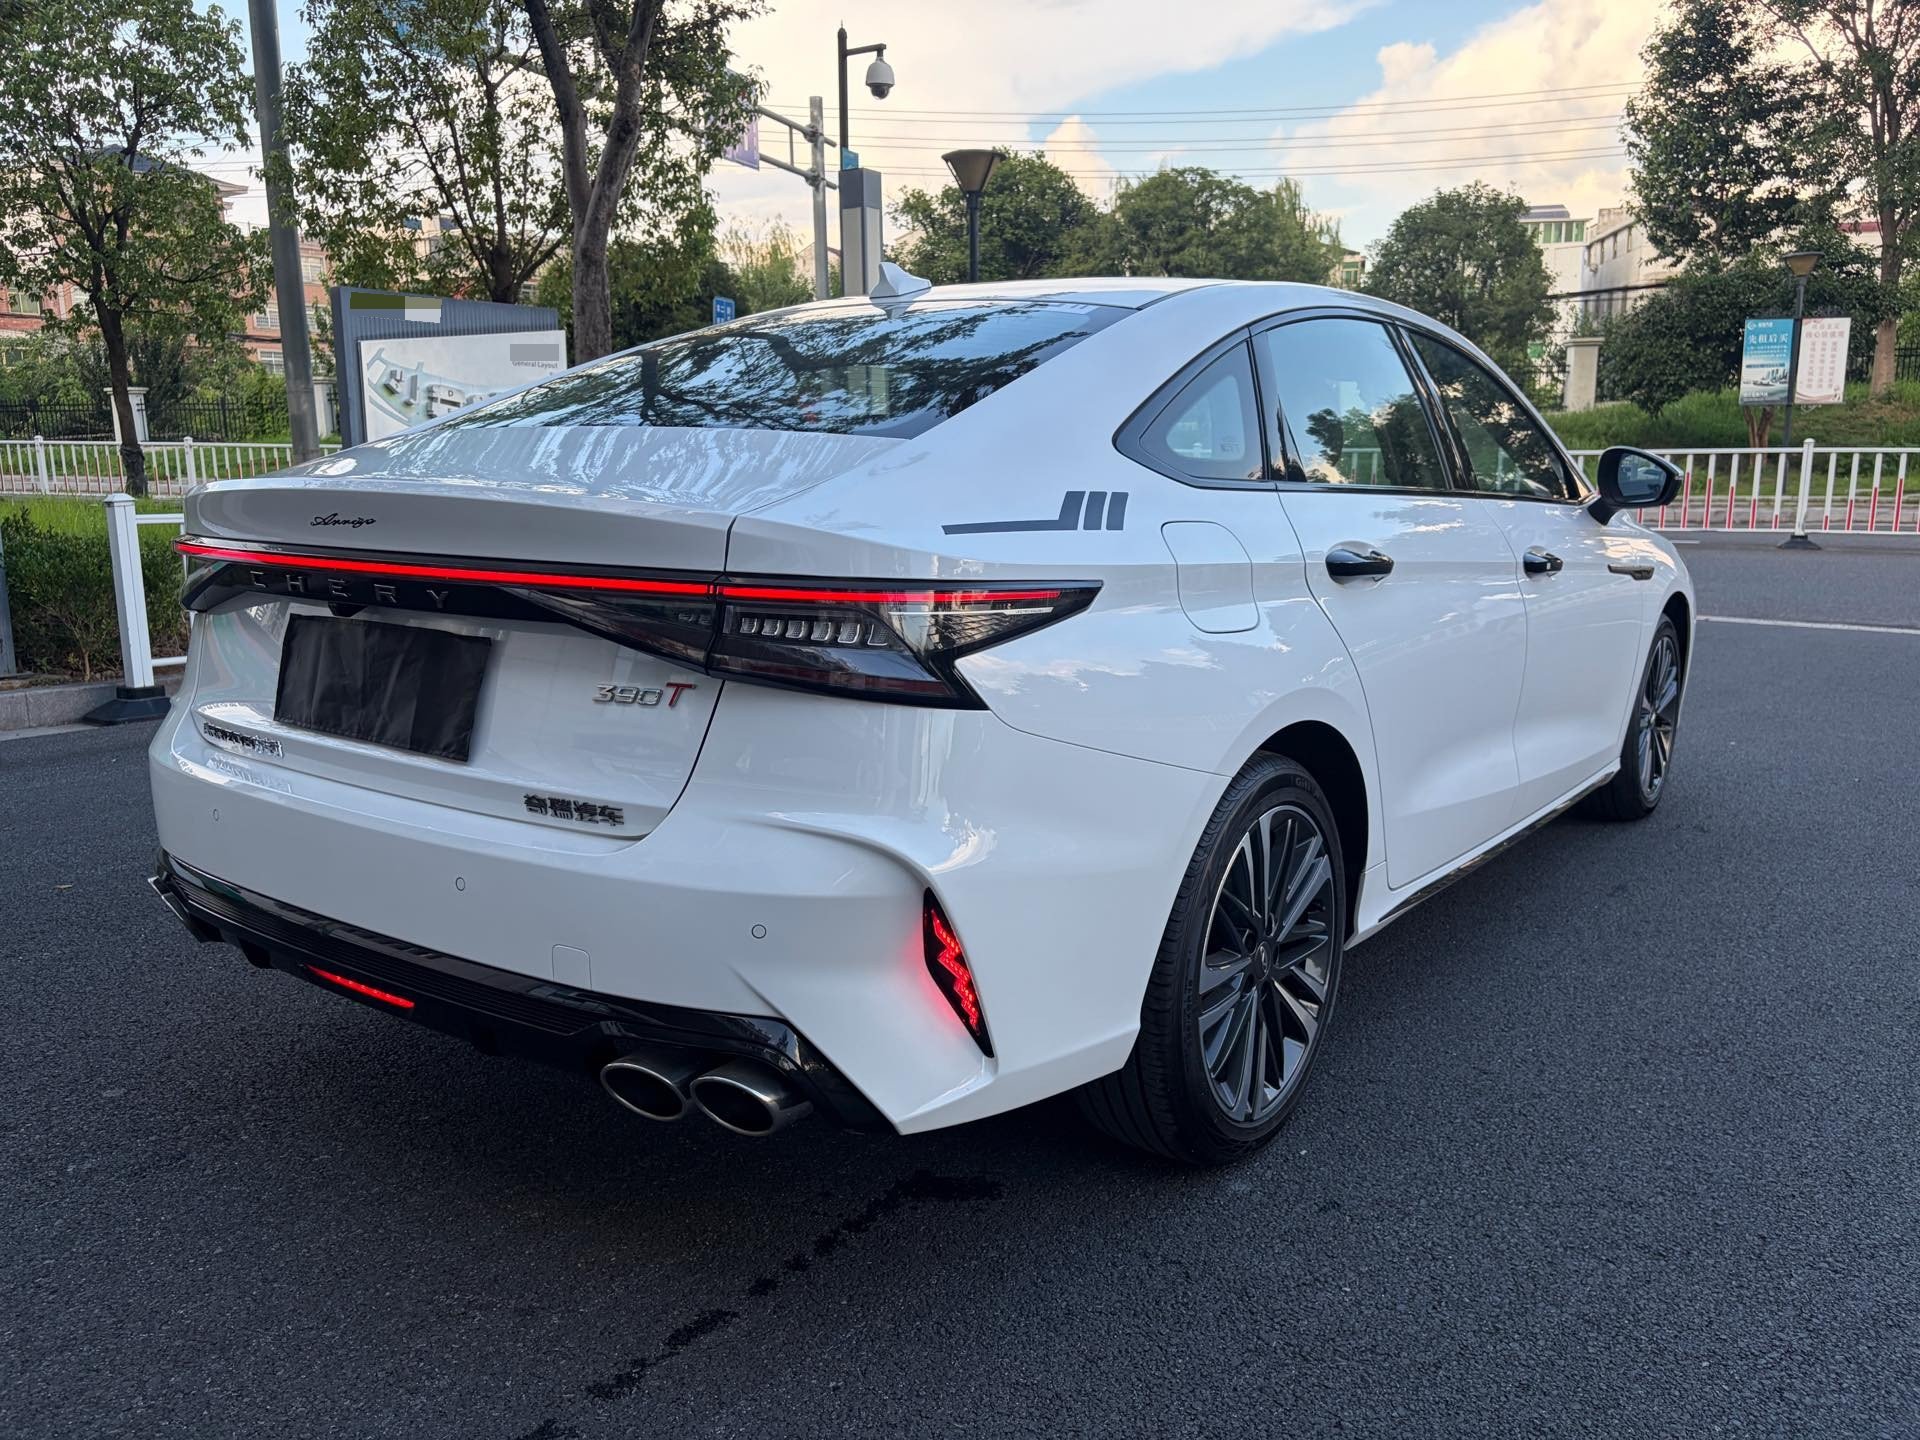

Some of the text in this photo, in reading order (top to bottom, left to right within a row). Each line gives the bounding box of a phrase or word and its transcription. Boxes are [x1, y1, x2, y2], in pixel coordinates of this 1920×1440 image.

[537, 361, 558, 369] Layout
[249, 570, 450, 609] CHERY
[592, 681, 697, 709] 390T
[523, 793, 625, 827] 奇瑞汽车
